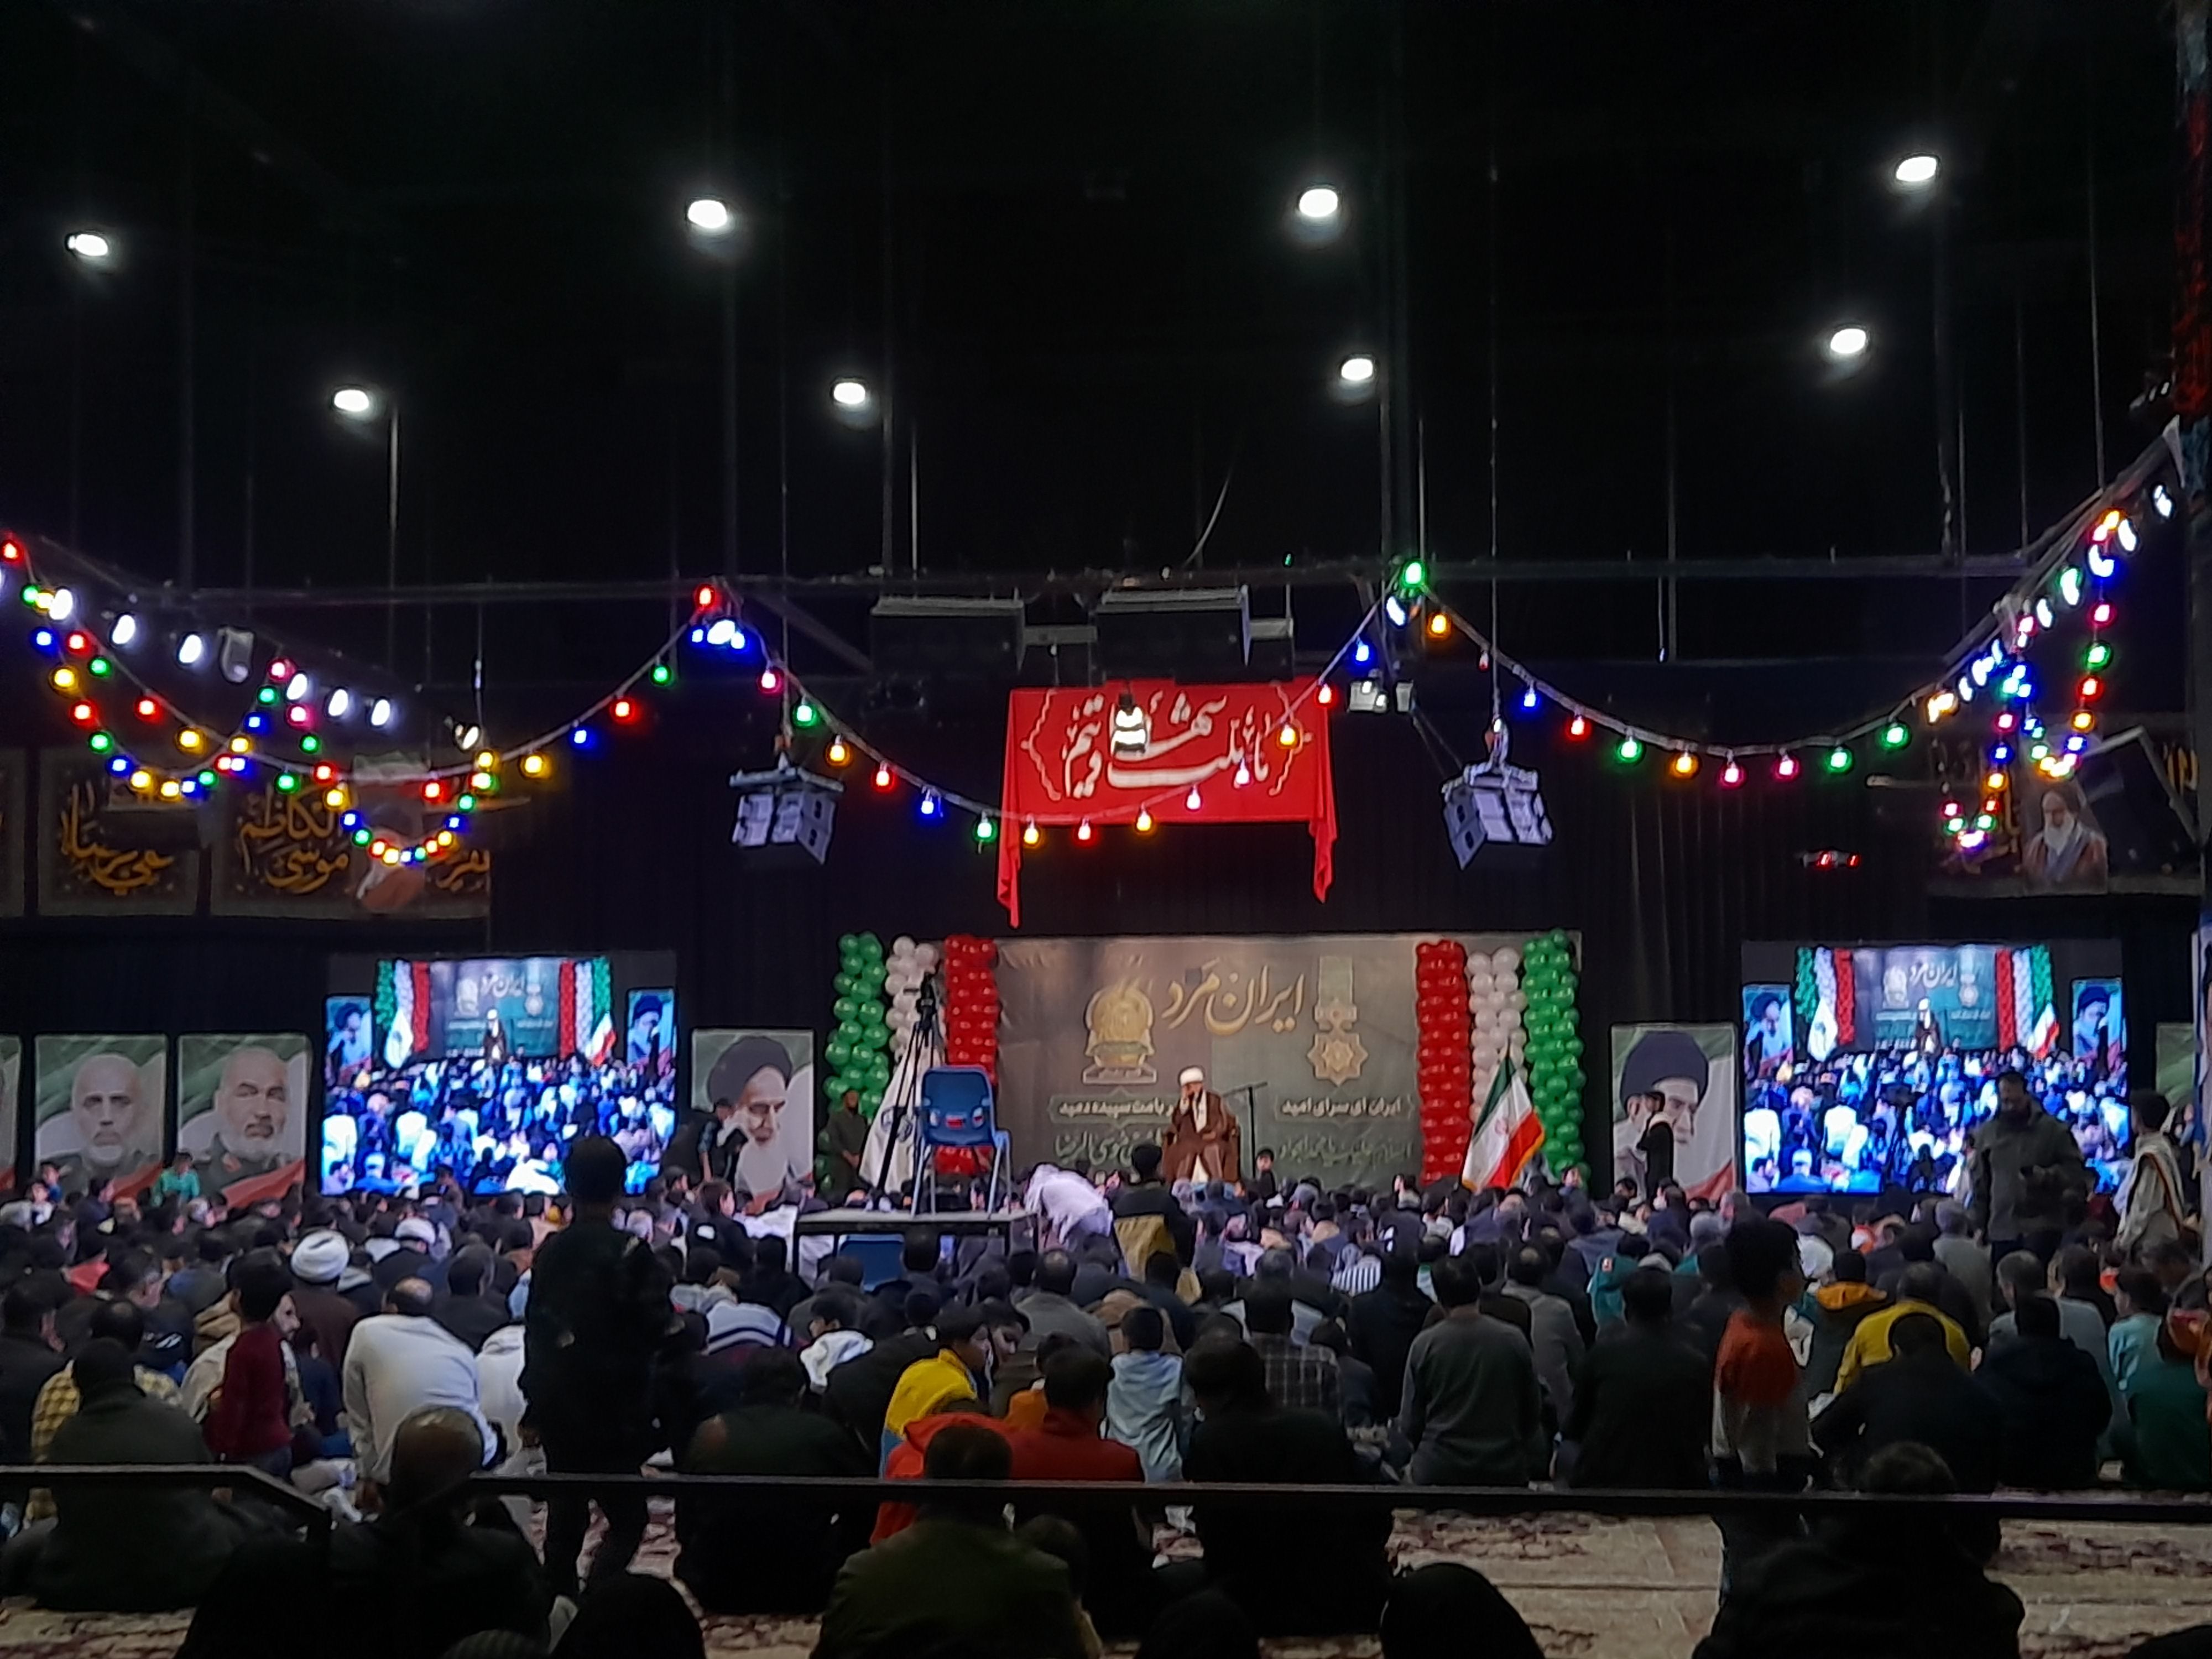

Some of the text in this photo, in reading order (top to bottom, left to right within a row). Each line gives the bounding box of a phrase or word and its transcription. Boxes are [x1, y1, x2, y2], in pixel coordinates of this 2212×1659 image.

[1204, 964, 1305, 1036] ایران
[1282, 1096, 1401, 1118] ایران ای سرای امید
